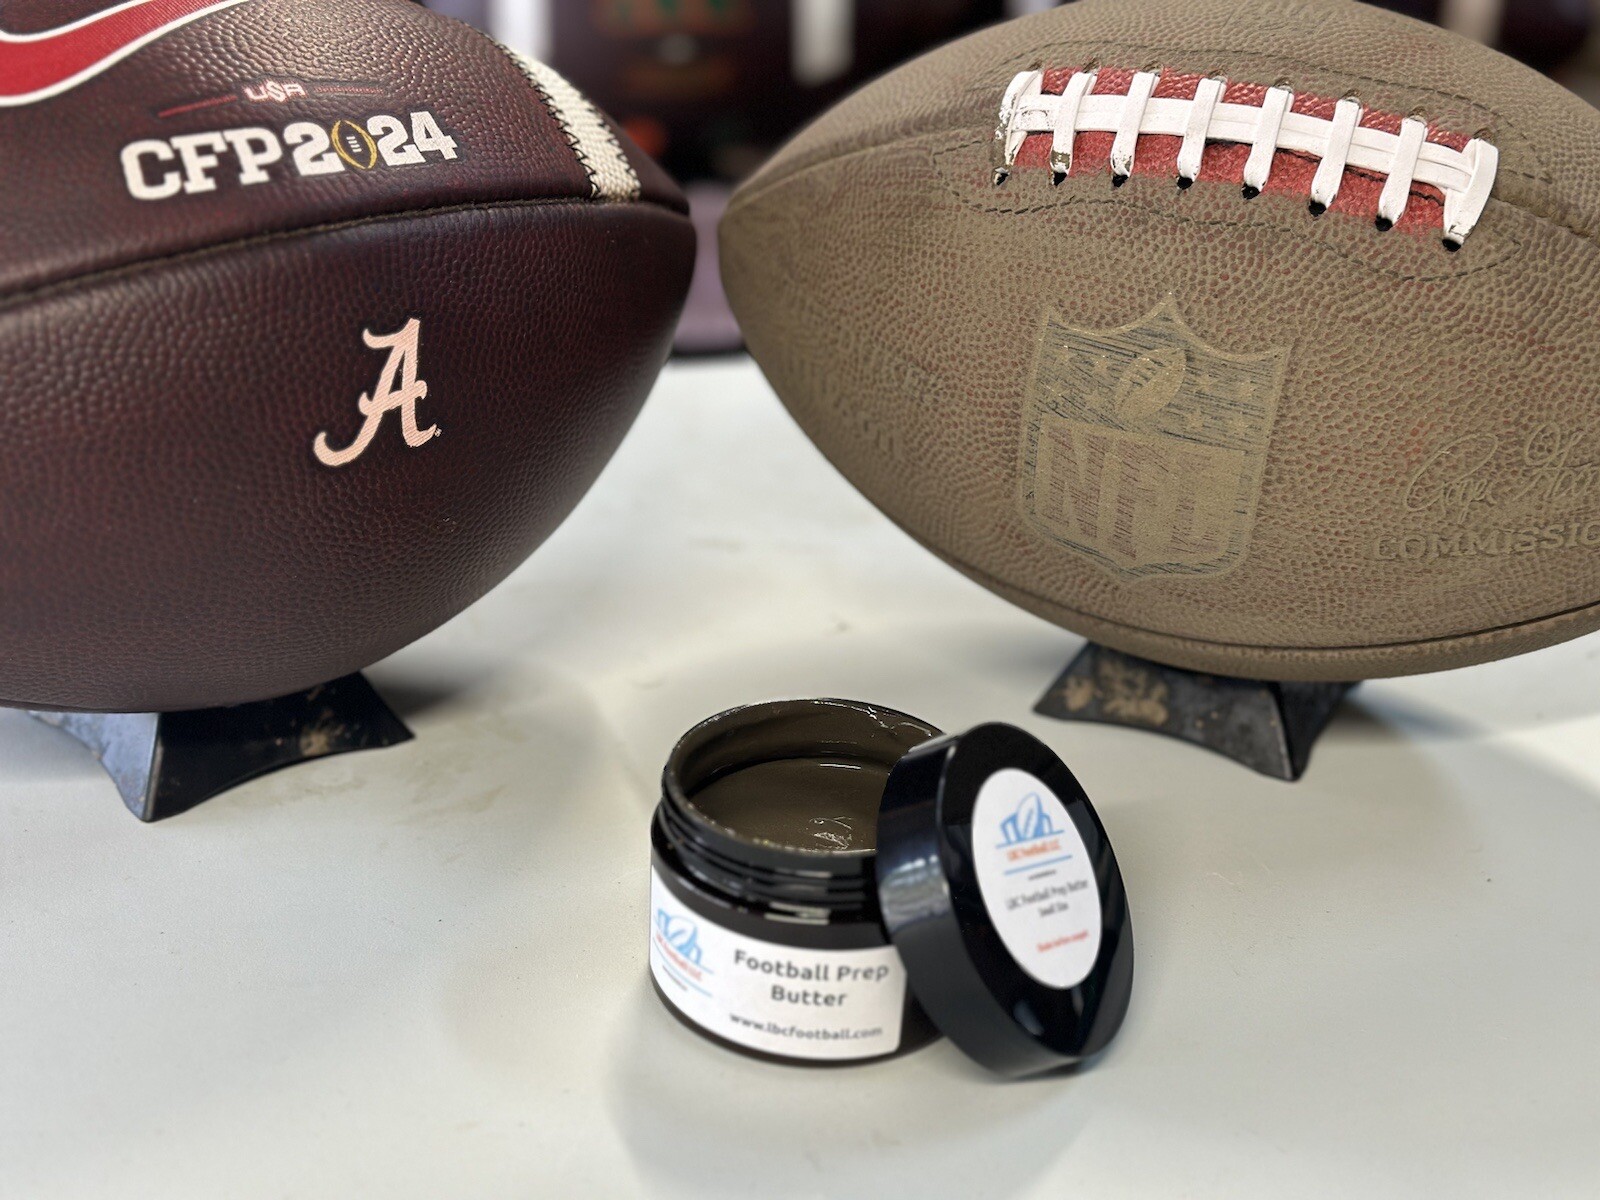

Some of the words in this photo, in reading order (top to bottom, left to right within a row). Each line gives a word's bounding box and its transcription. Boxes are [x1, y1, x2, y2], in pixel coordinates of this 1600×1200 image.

[243, 80, 306, 102] USA
[733, 950, 829, 981] Football
[837, 963, 889, 983] Prep
[771, 985, 847, 1007] Butter
